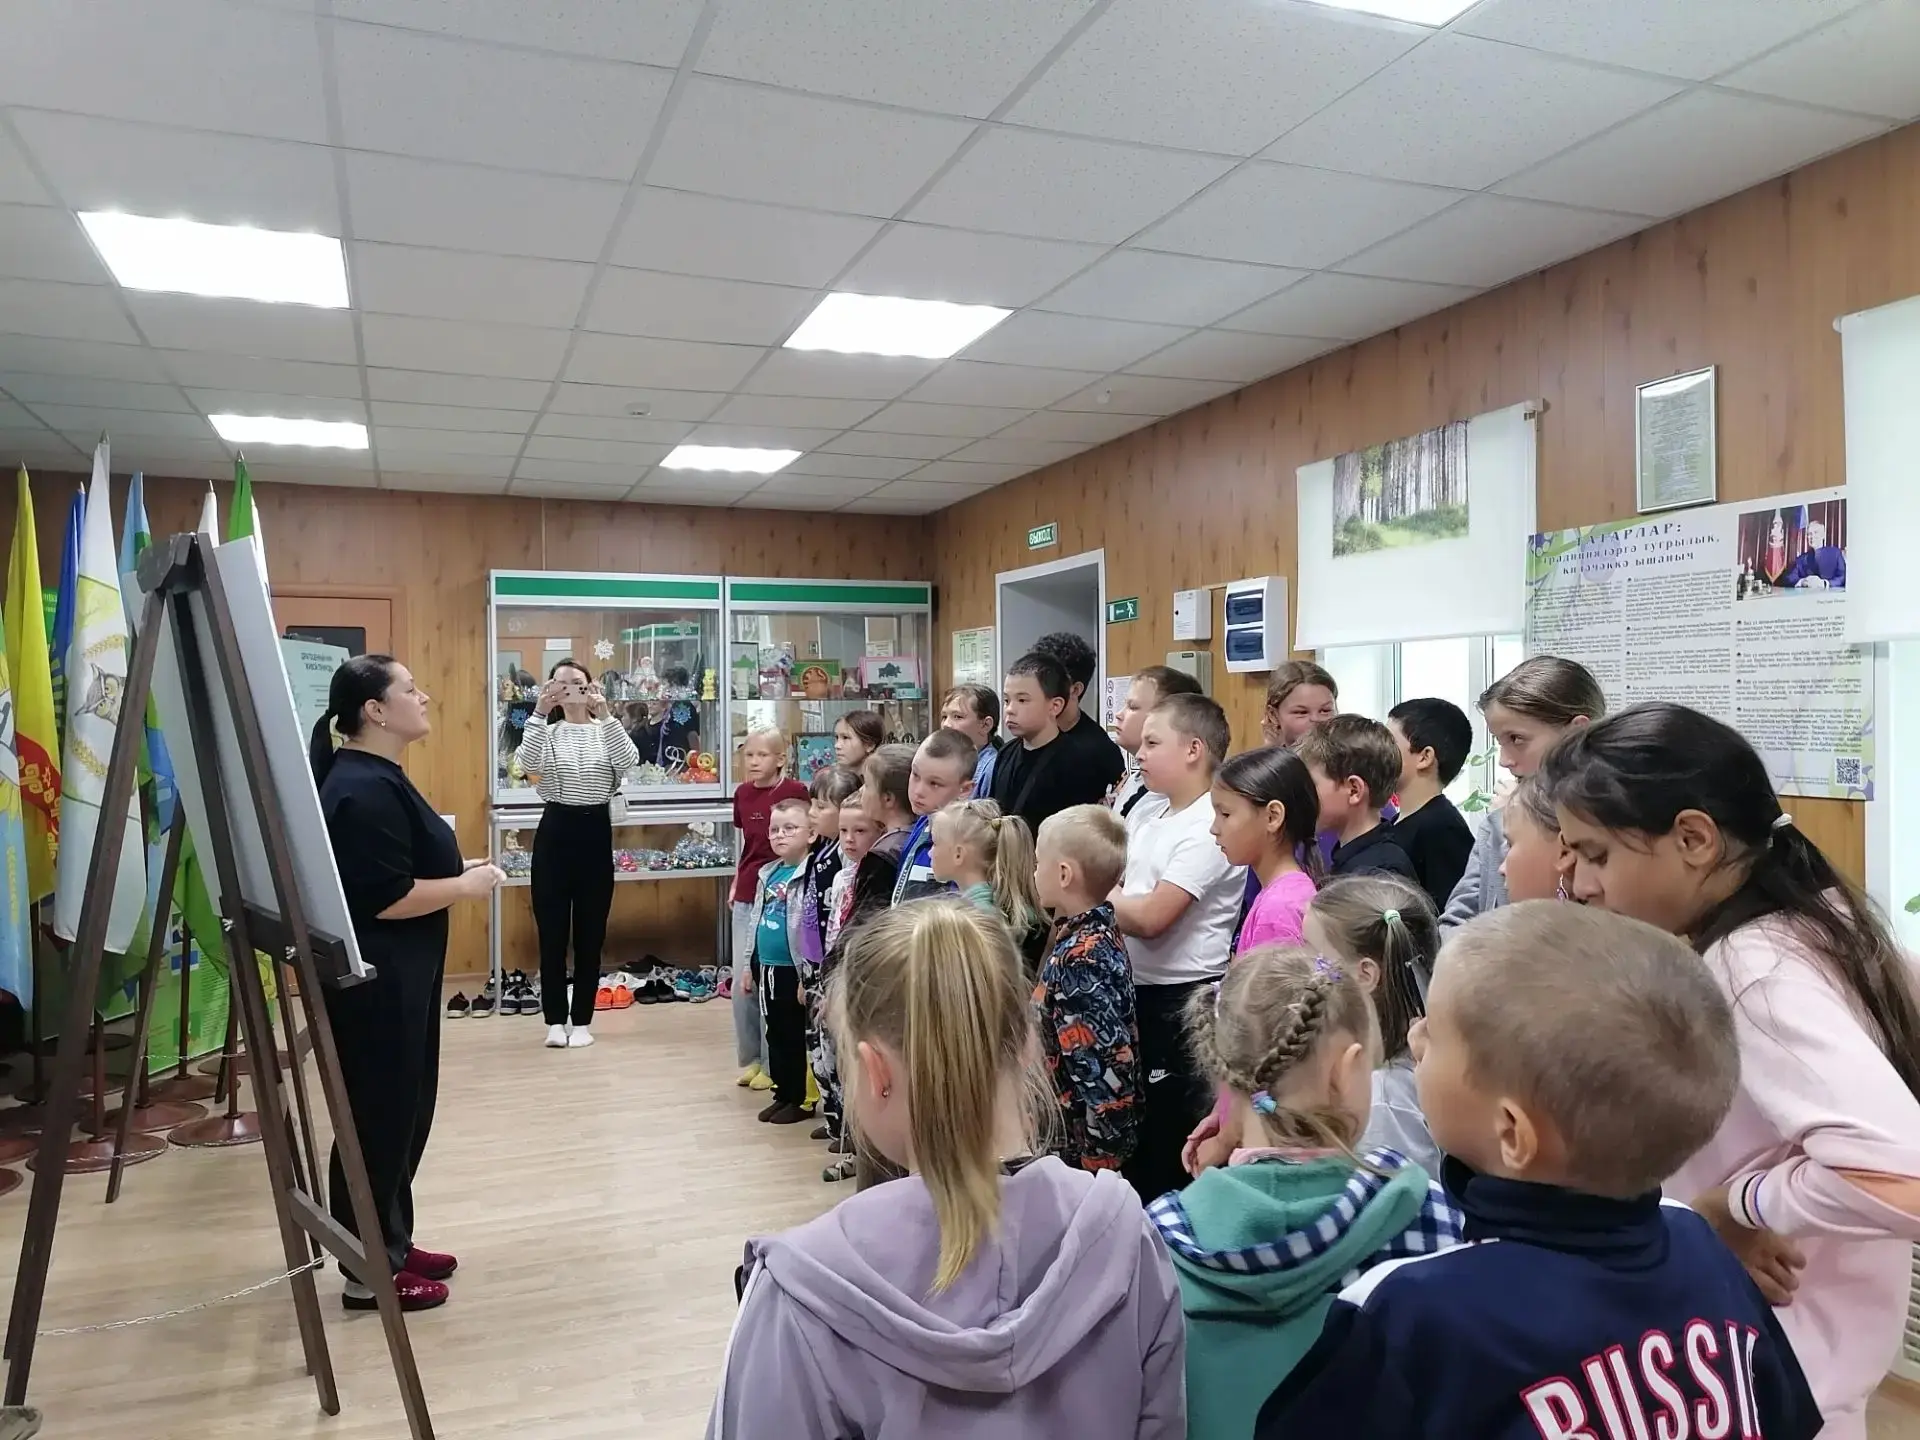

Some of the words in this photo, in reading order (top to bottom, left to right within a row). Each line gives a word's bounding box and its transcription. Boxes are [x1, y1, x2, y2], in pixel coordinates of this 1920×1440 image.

[1029, 526, 1052, 545] ВЫХОД
[1635, 552, 1694, 567] ышаныч
[1150, 1068, 1166, 1077] NIKE
